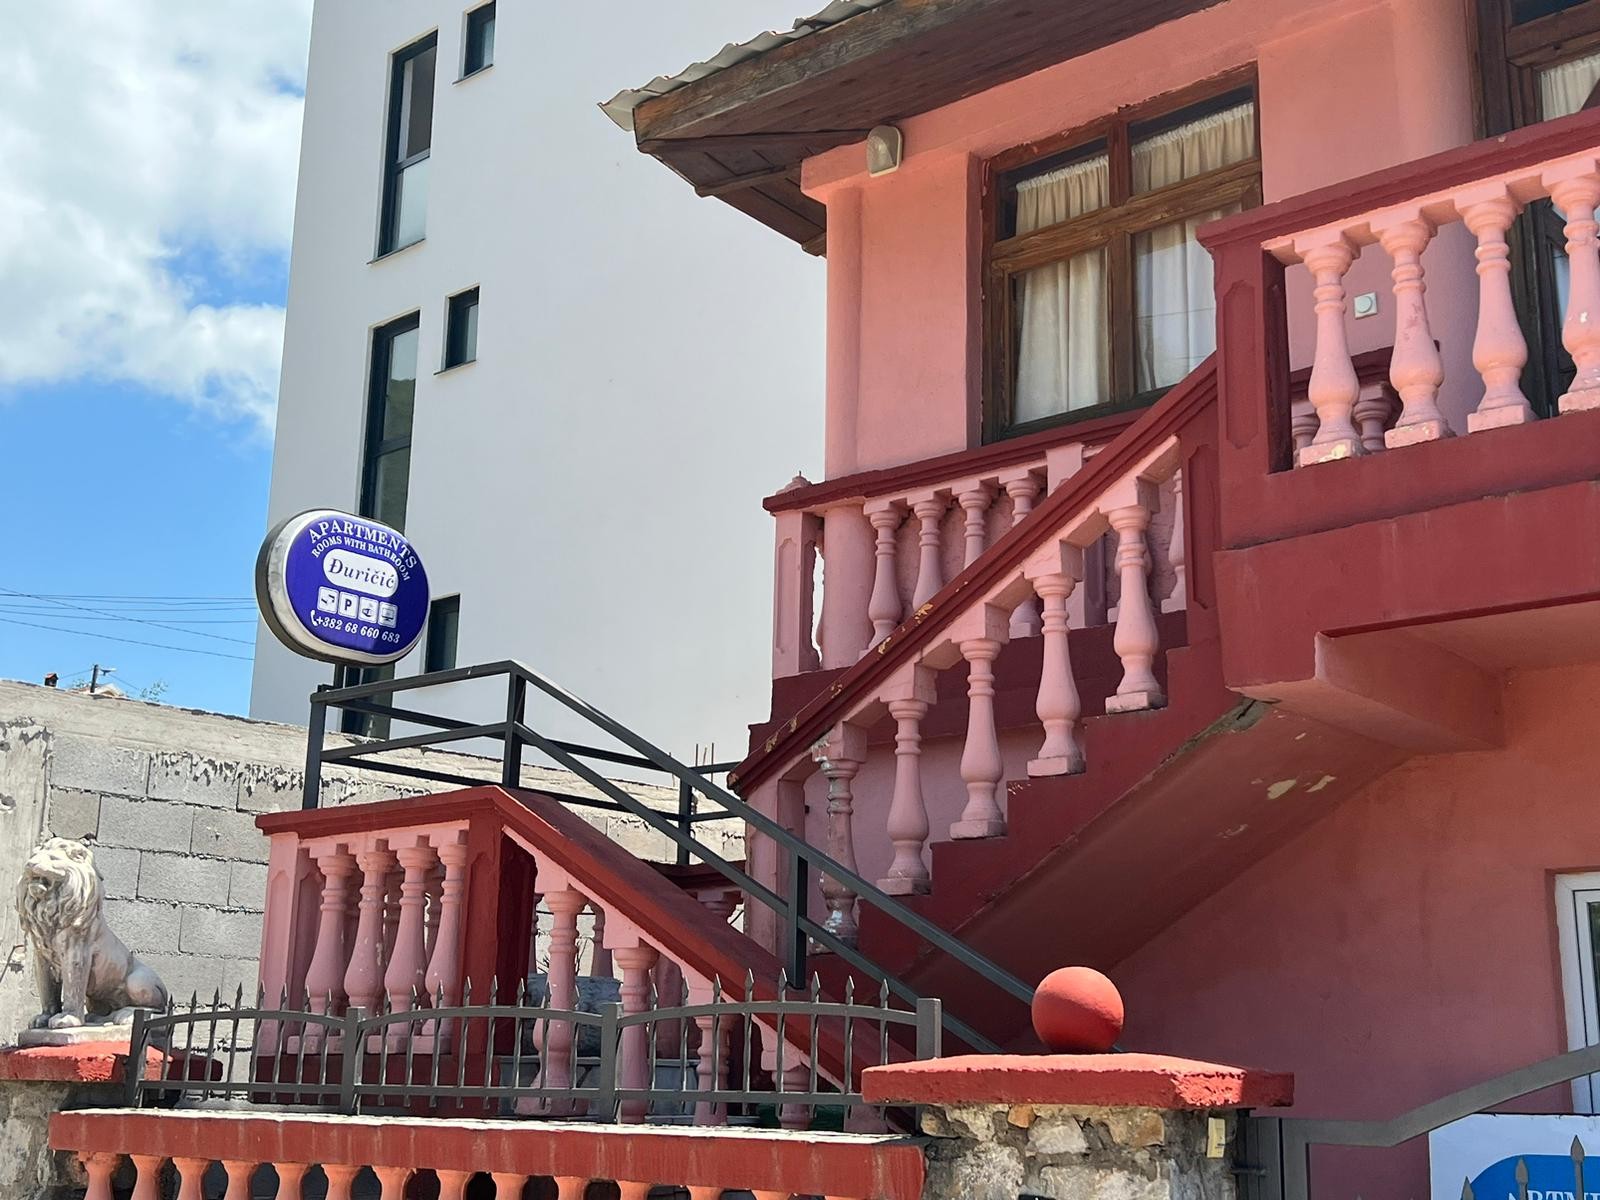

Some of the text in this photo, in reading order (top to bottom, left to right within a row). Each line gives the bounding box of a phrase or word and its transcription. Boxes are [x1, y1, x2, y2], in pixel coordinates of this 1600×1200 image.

[308, 519, 417, 569] APARTMENTS
[311, 536, 410, 581] ROOMS WITH BATHROOM
[329, 558, 394, 589] Đuričić
[345, 598, 352, 611] P
[316, 615, 401, 644] +382 68 660 683
